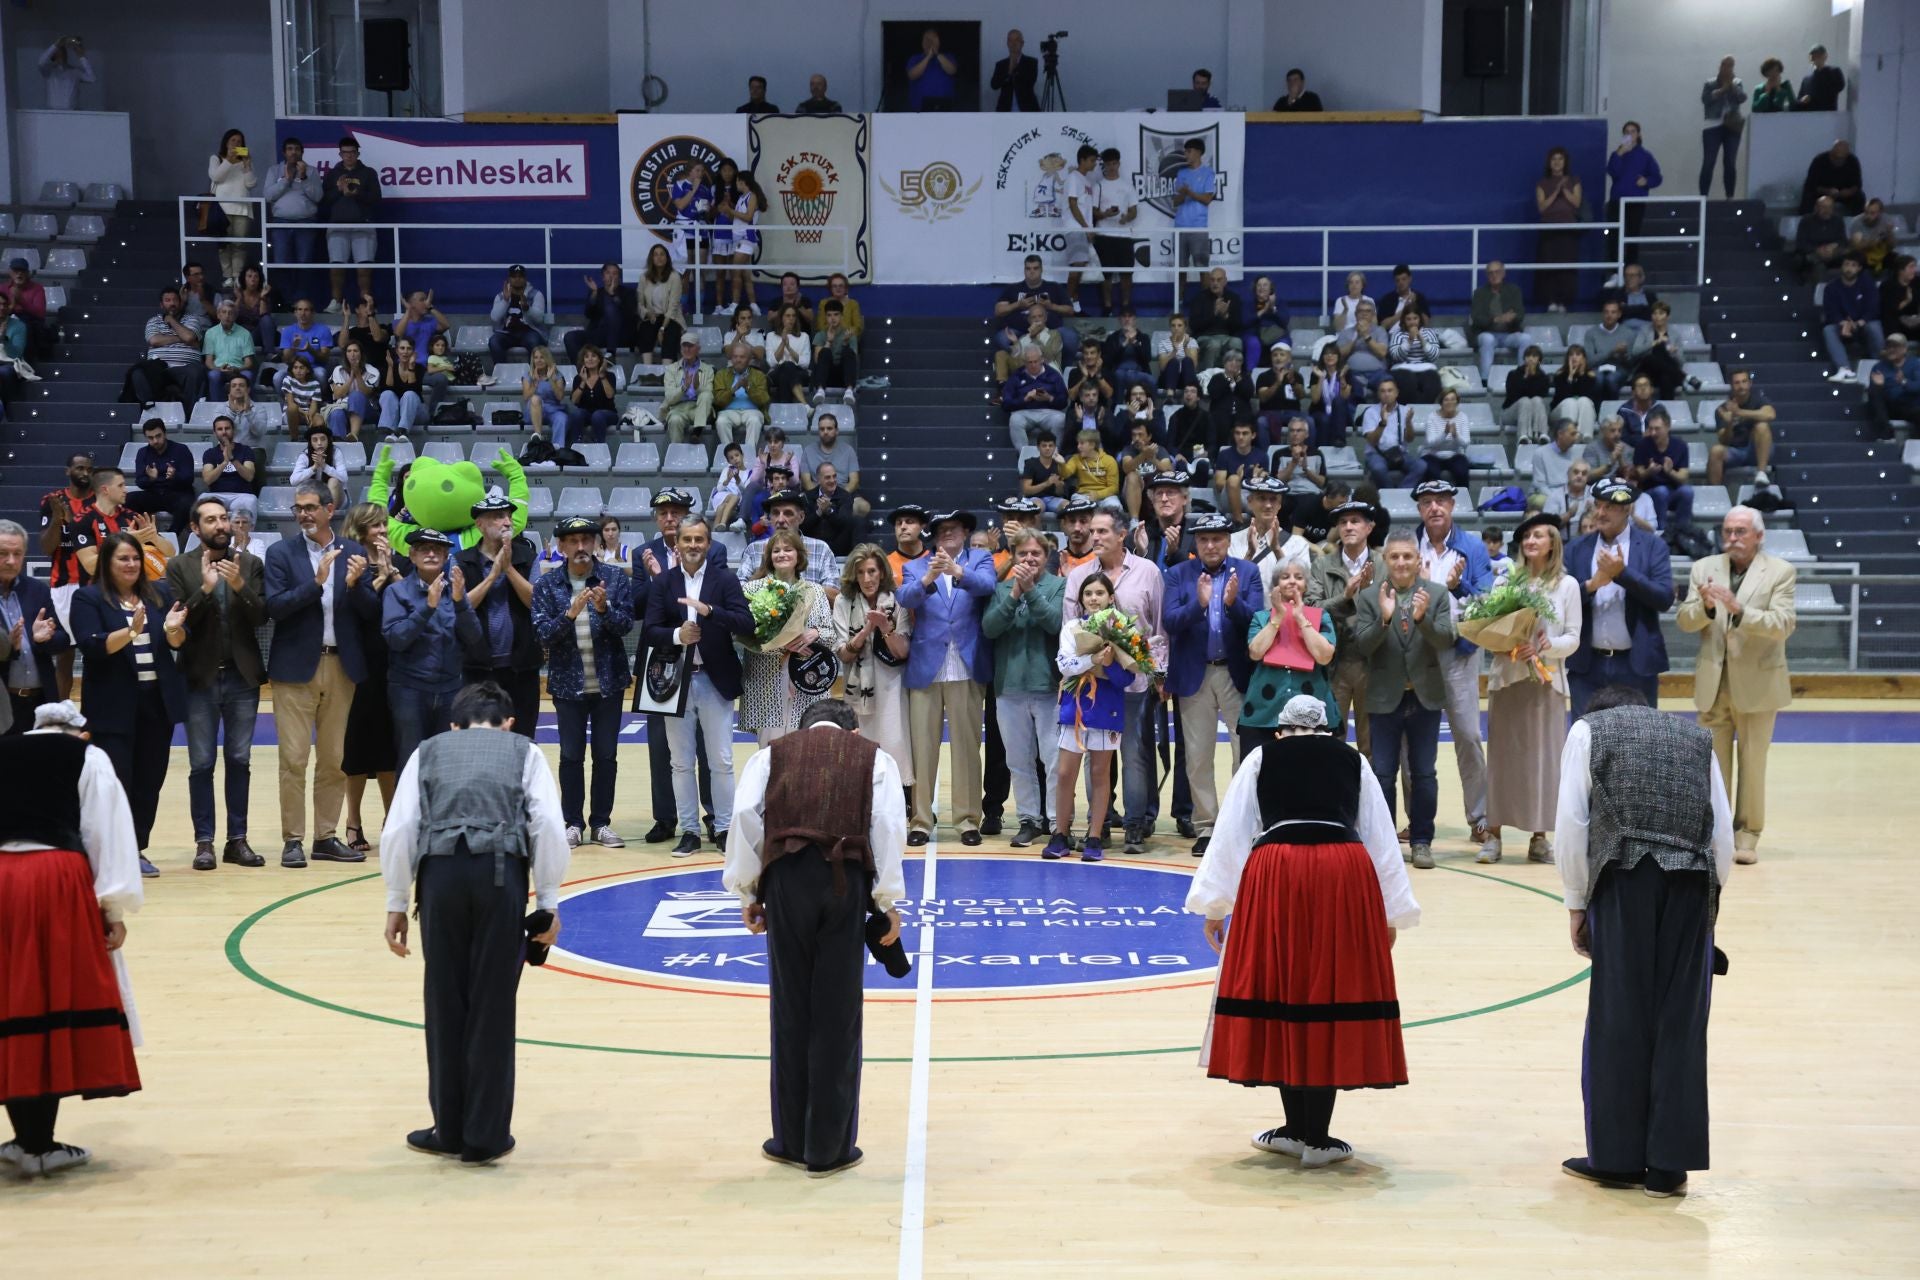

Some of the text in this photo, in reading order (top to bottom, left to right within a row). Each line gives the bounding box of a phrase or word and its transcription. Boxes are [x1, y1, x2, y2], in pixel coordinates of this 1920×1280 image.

[317, 158, 573, 186] #azenNeskak
[776, 152, 840, 185] ASKATUAK
[996, 128, 1042, 190] ASKATUAK
[638, 144, 677, 212] DONOSTIA
[1135, 175, 1179, 200] BILBA
[891, 898, 1077, 907] ONOSTIA
[900, 919, 1157, 927] nostia Kirola
